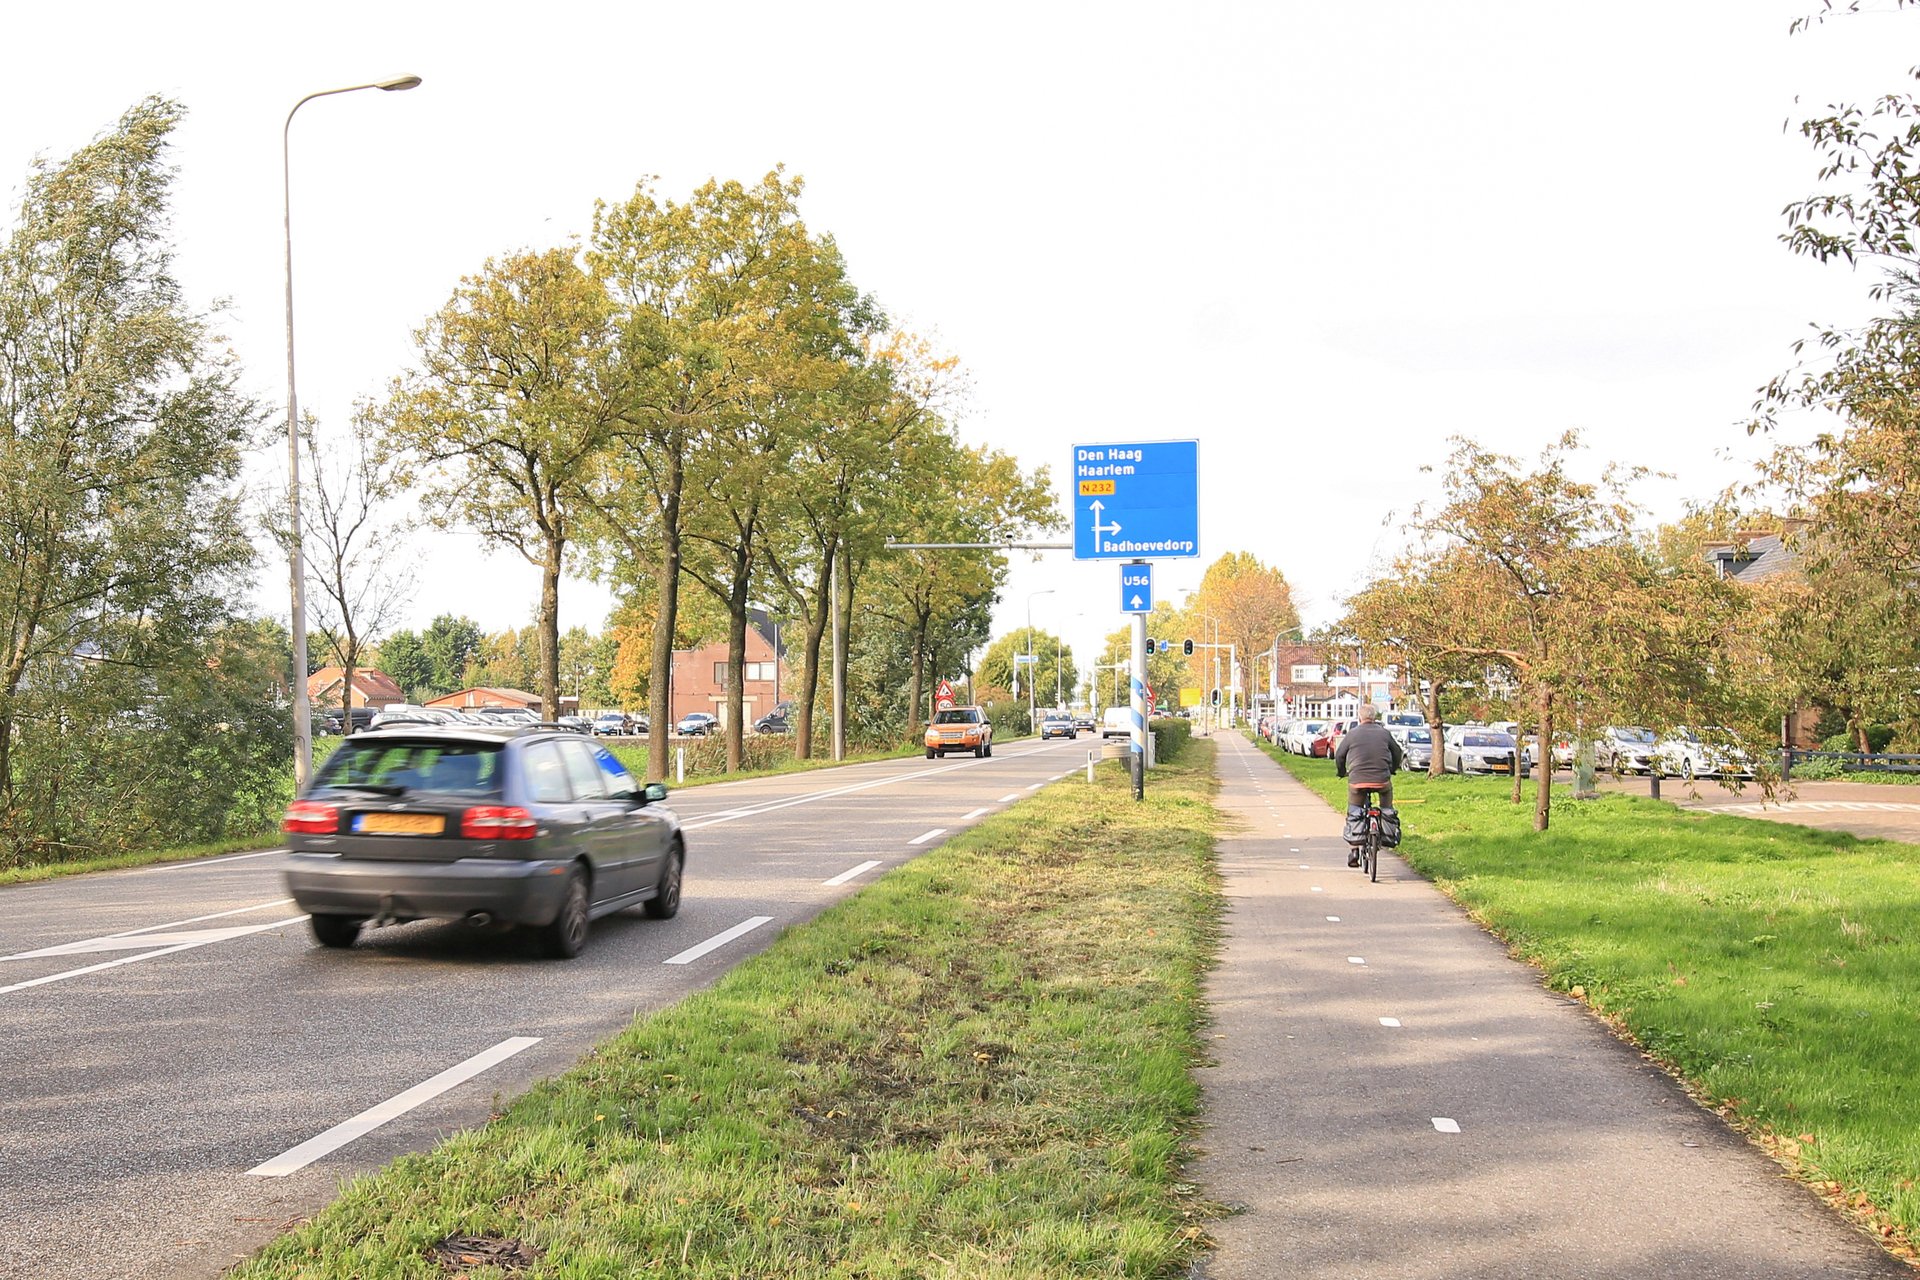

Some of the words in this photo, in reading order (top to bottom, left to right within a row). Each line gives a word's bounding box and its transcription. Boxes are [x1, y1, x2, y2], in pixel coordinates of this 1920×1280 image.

[1078, 449, 1104, 461] Den
[1109, 448, 1142, 462] Haag
[1078, 464, 1135, 476] Haarlem
[1104, 539, 1193, 552] Badhoevedorp
[1124, 576, 1148, 585] U56
